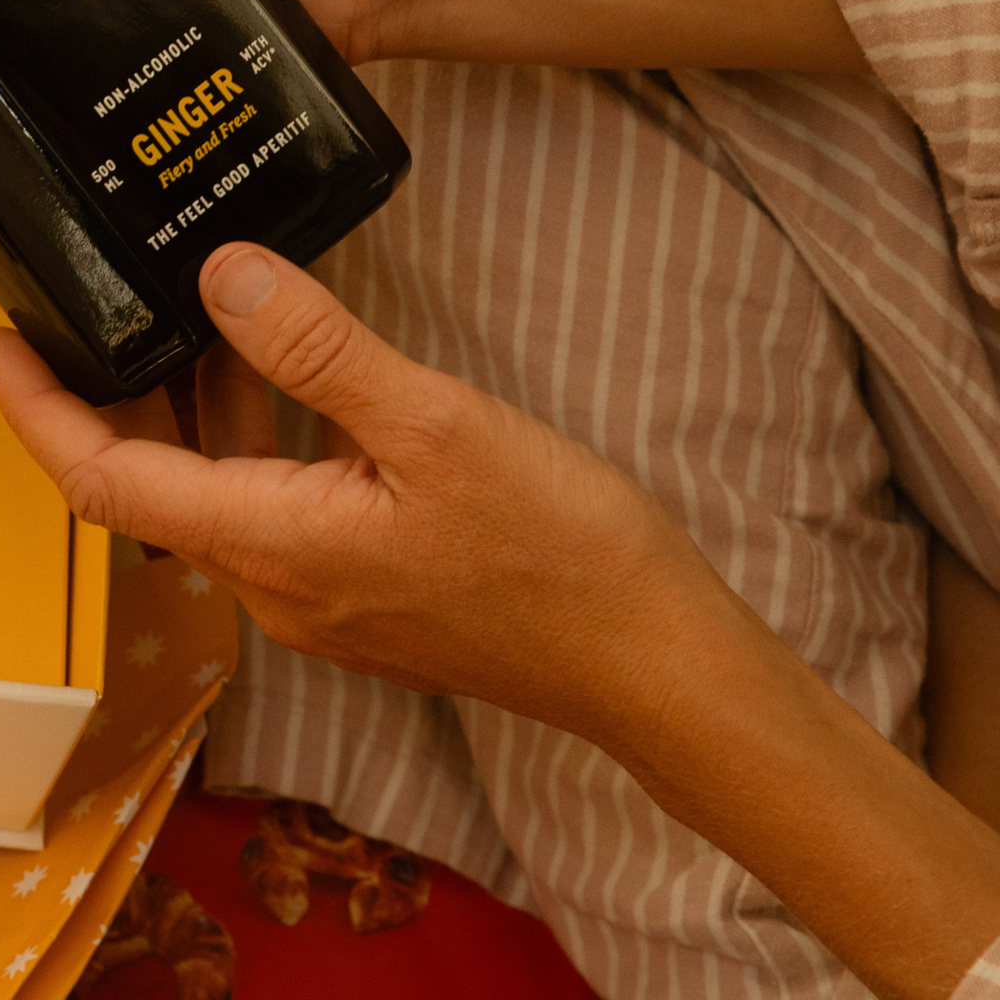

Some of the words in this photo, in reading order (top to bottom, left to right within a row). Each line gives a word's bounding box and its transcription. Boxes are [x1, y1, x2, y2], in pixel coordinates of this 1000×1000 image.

[93, 26, 202, 118] NON-ALCOHOLIC
[239, 35, 269, 62] WITH
[131, 68, 244, 167] GINGER
[158, 156, 194, 189] Fiery
[194, 131, 221, 161] and
[219, 103, 258, 140] Fresh
[91, 159, 116, 183] 500
[104, 175, 124, 194] ML
[147, 222, 178, 251] THE
[176, 196, 214, 228] FEEL
[212, 163, 250, 198] GOOD
[251, 111, 311, 168] APERITIF
